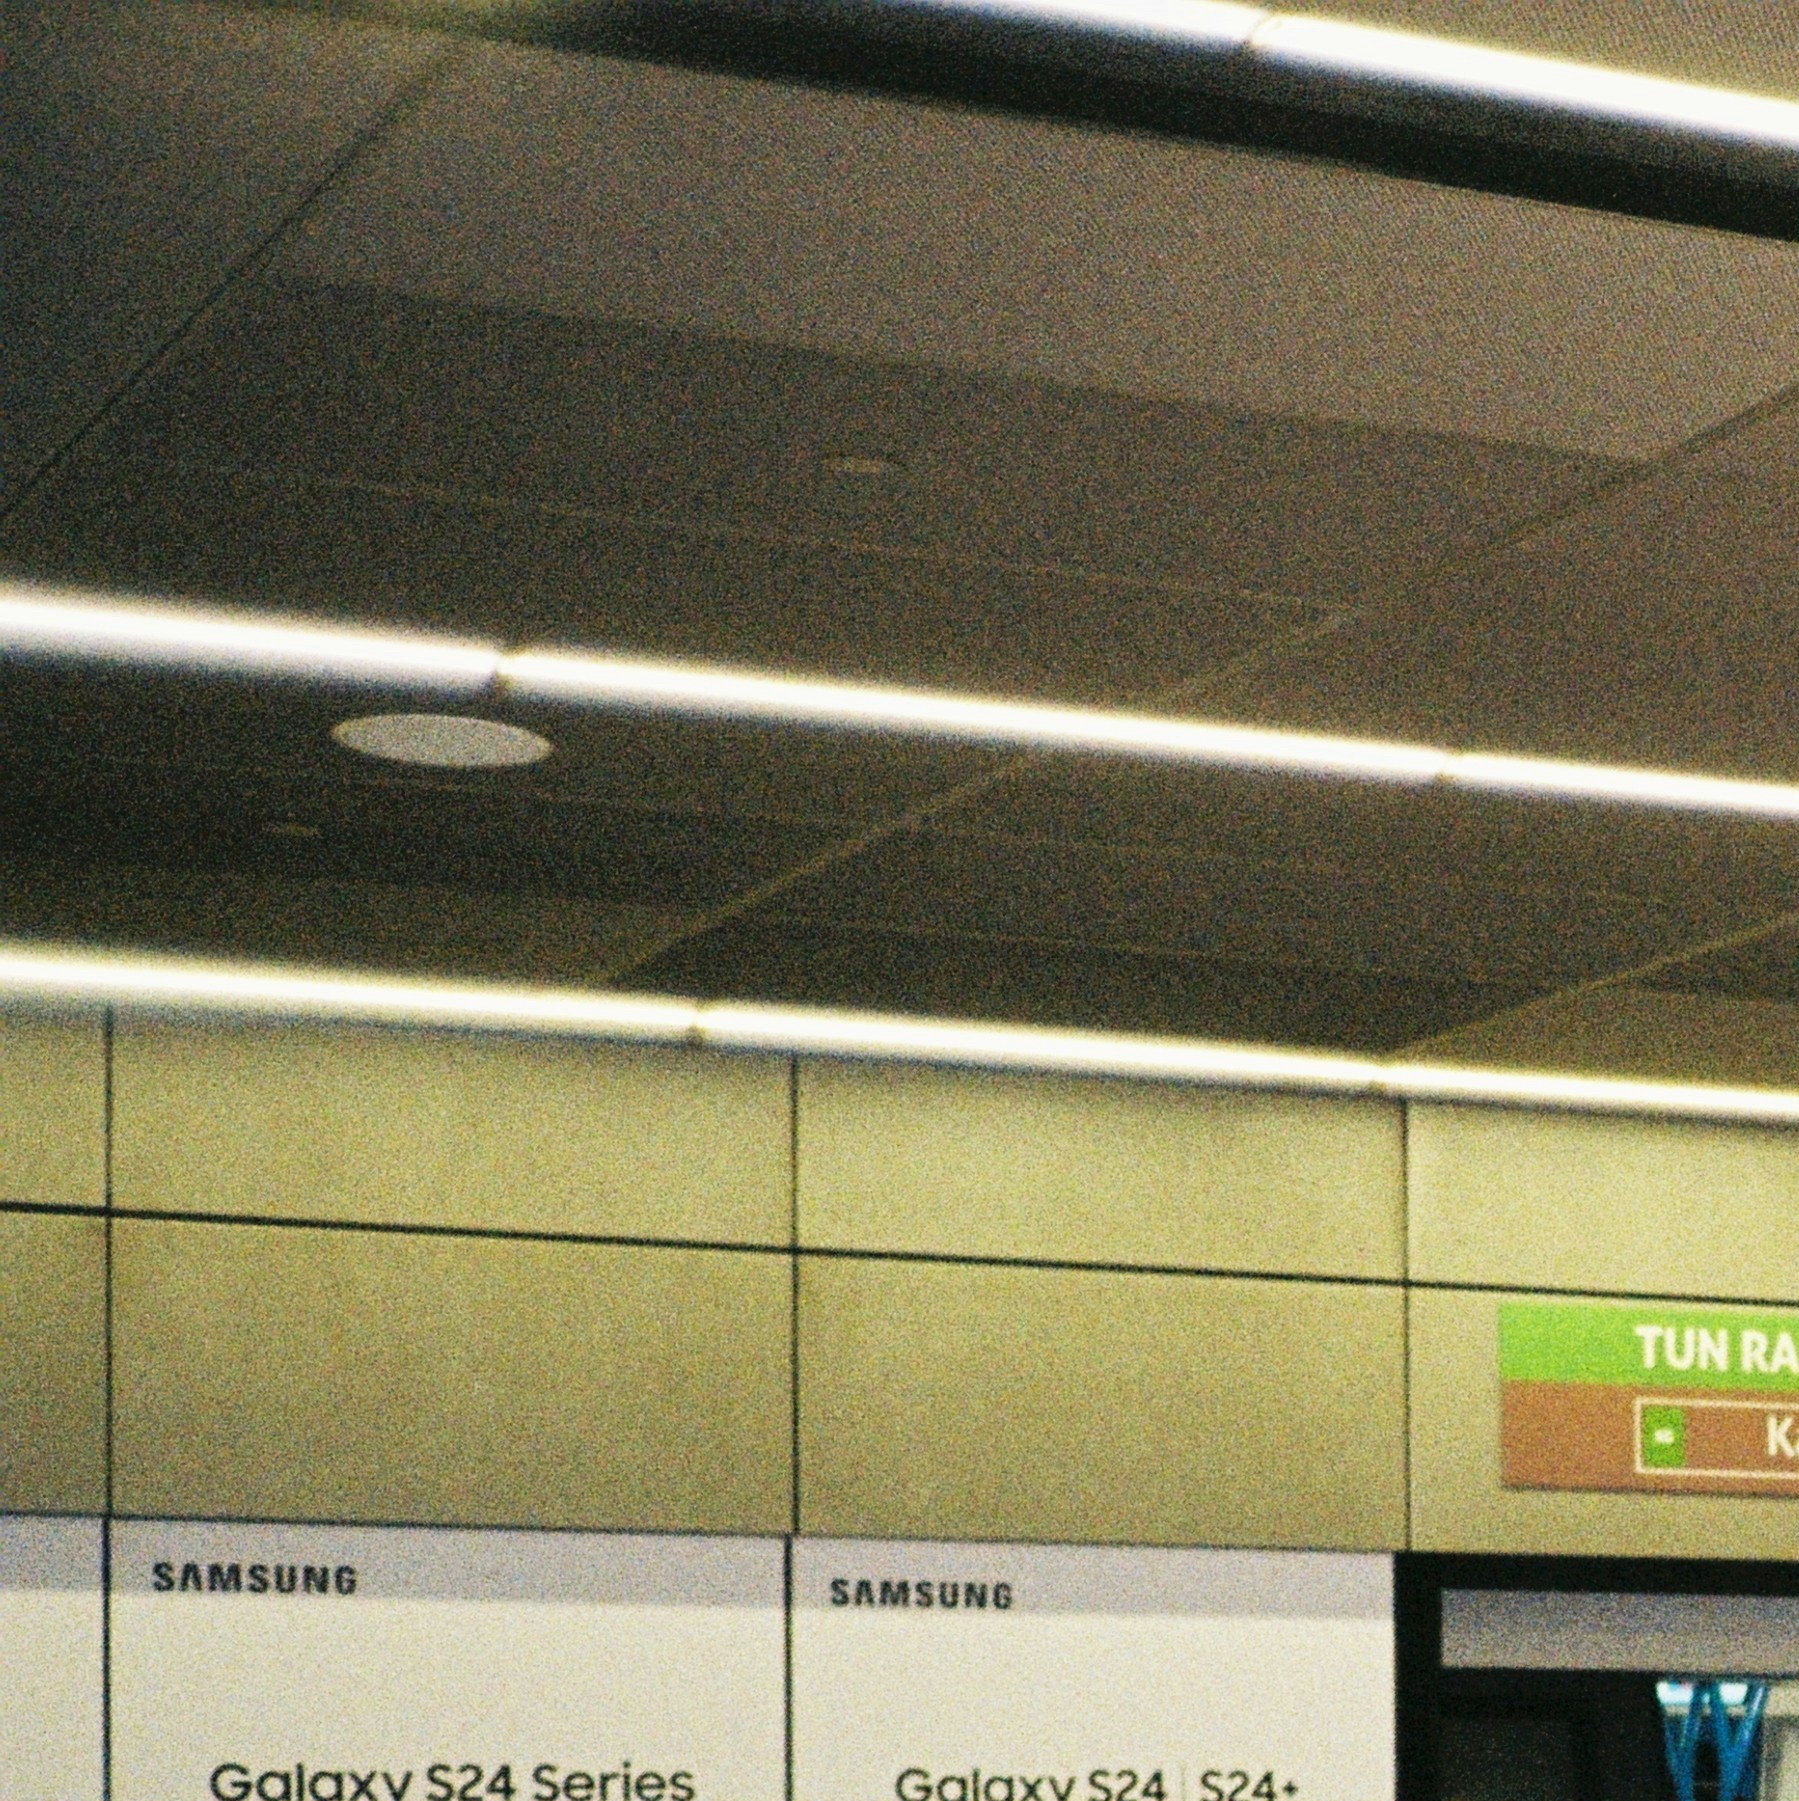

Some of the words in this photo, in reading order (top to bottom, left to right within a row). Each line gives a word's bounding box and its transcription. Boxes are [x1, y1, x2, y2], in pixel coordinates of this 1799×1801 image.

[1634, 1323, 1730, 1373] TUN
[153, 1562, 358, 1596] SAMSUNG
[830, 1578, 1013, 1609] SAMSUNG
